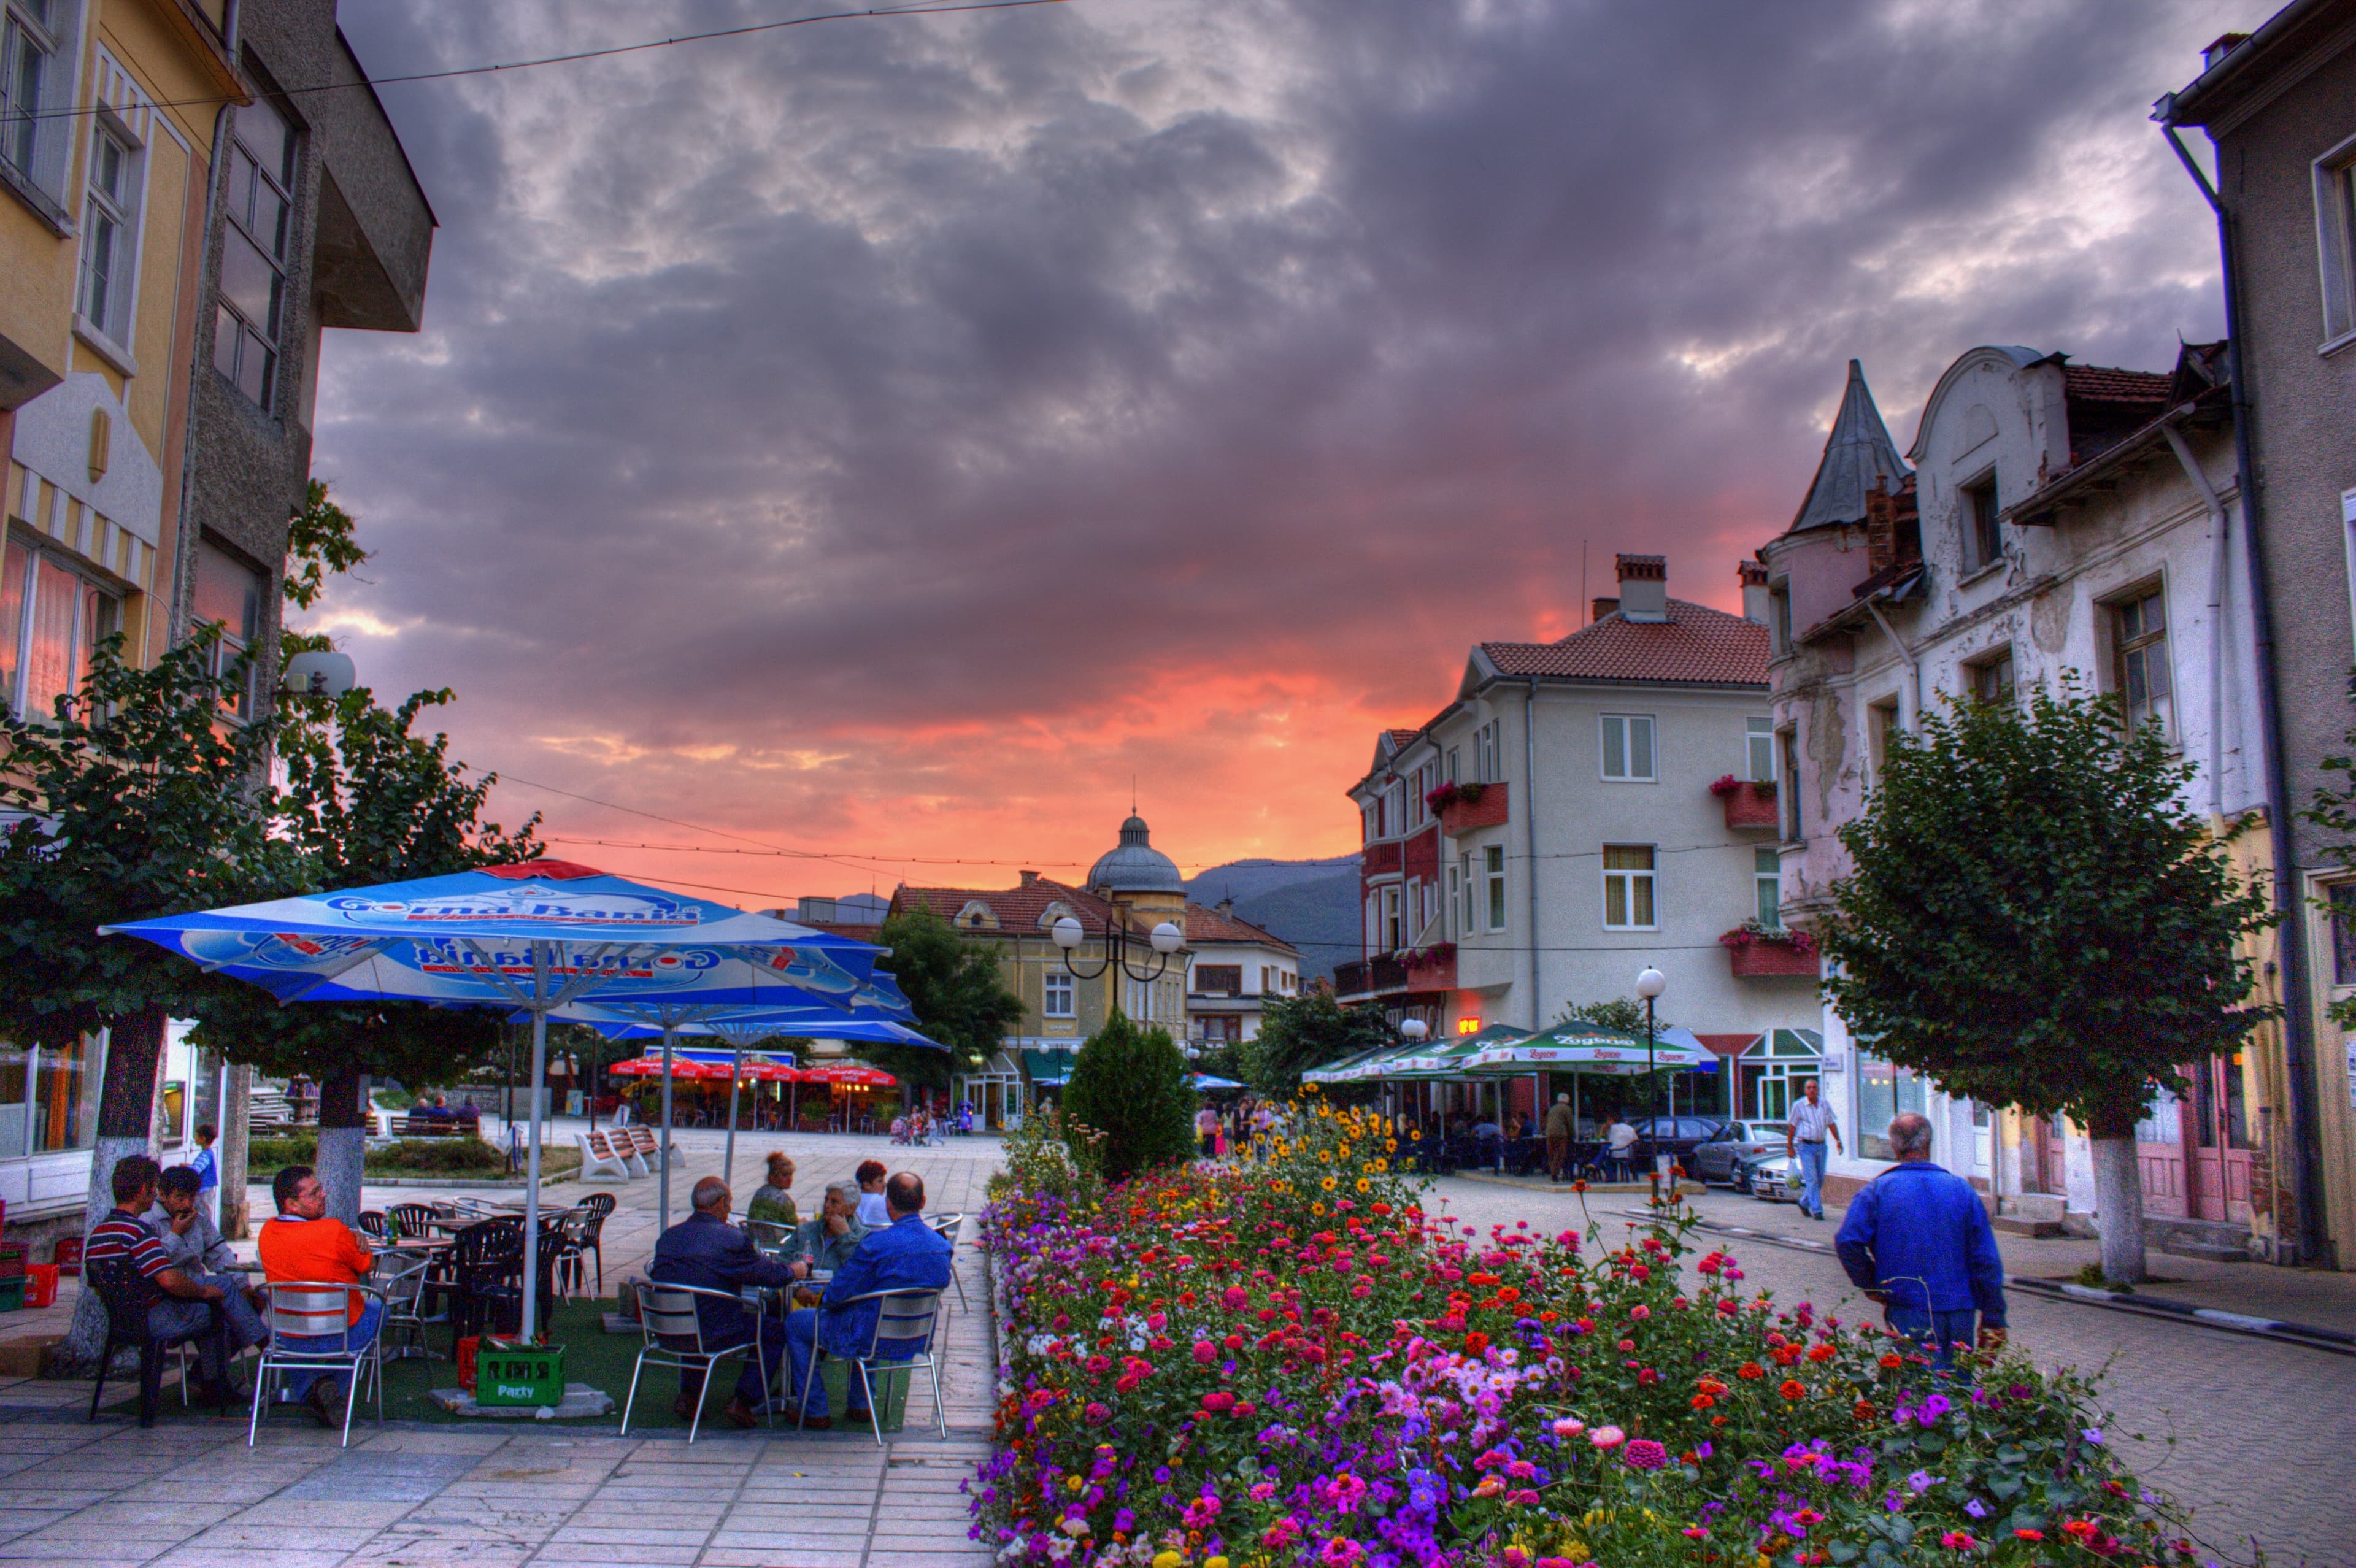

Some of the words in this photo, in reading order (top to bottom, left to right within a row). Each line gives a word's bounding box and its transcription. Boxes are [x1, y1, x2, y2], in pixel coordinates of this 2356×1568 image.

[327, 897, 510, 914] Gorna
[532, 904, 698, 920] Bania
[498, 1385, 534, 1399] Party
